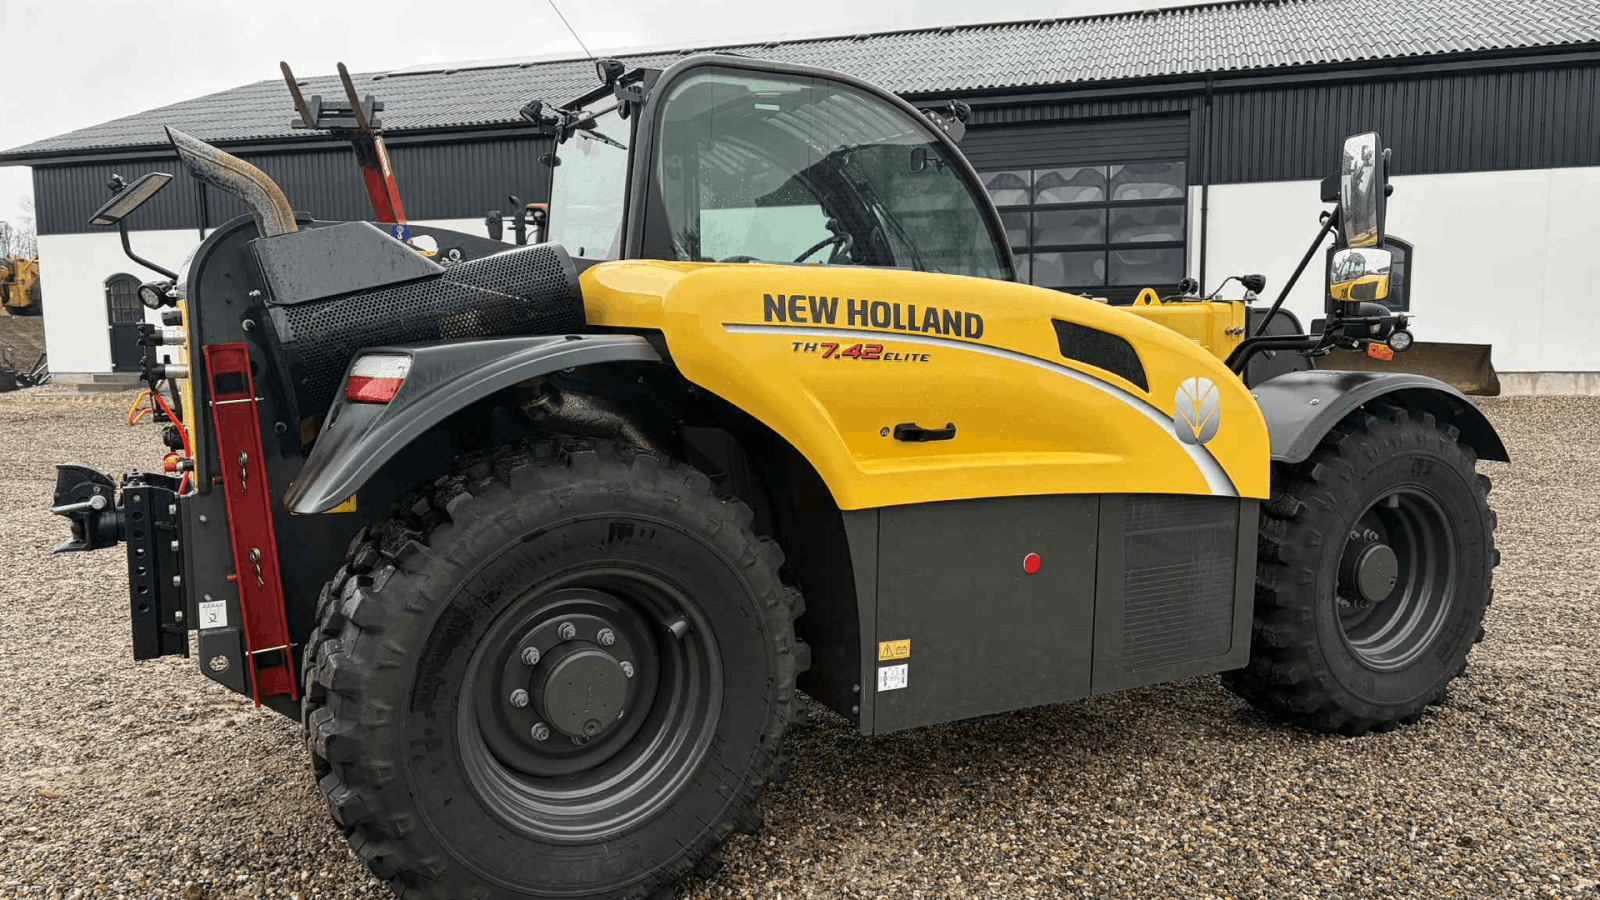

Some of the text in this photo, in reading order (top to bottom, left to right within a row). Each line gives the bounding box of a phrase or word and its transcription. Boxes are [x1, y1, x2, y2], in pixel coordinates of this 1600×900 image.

[763, 293, 984, 340] NEW HOLLAND
[792, 342, 931, 362] TH 7.42 ELITE
